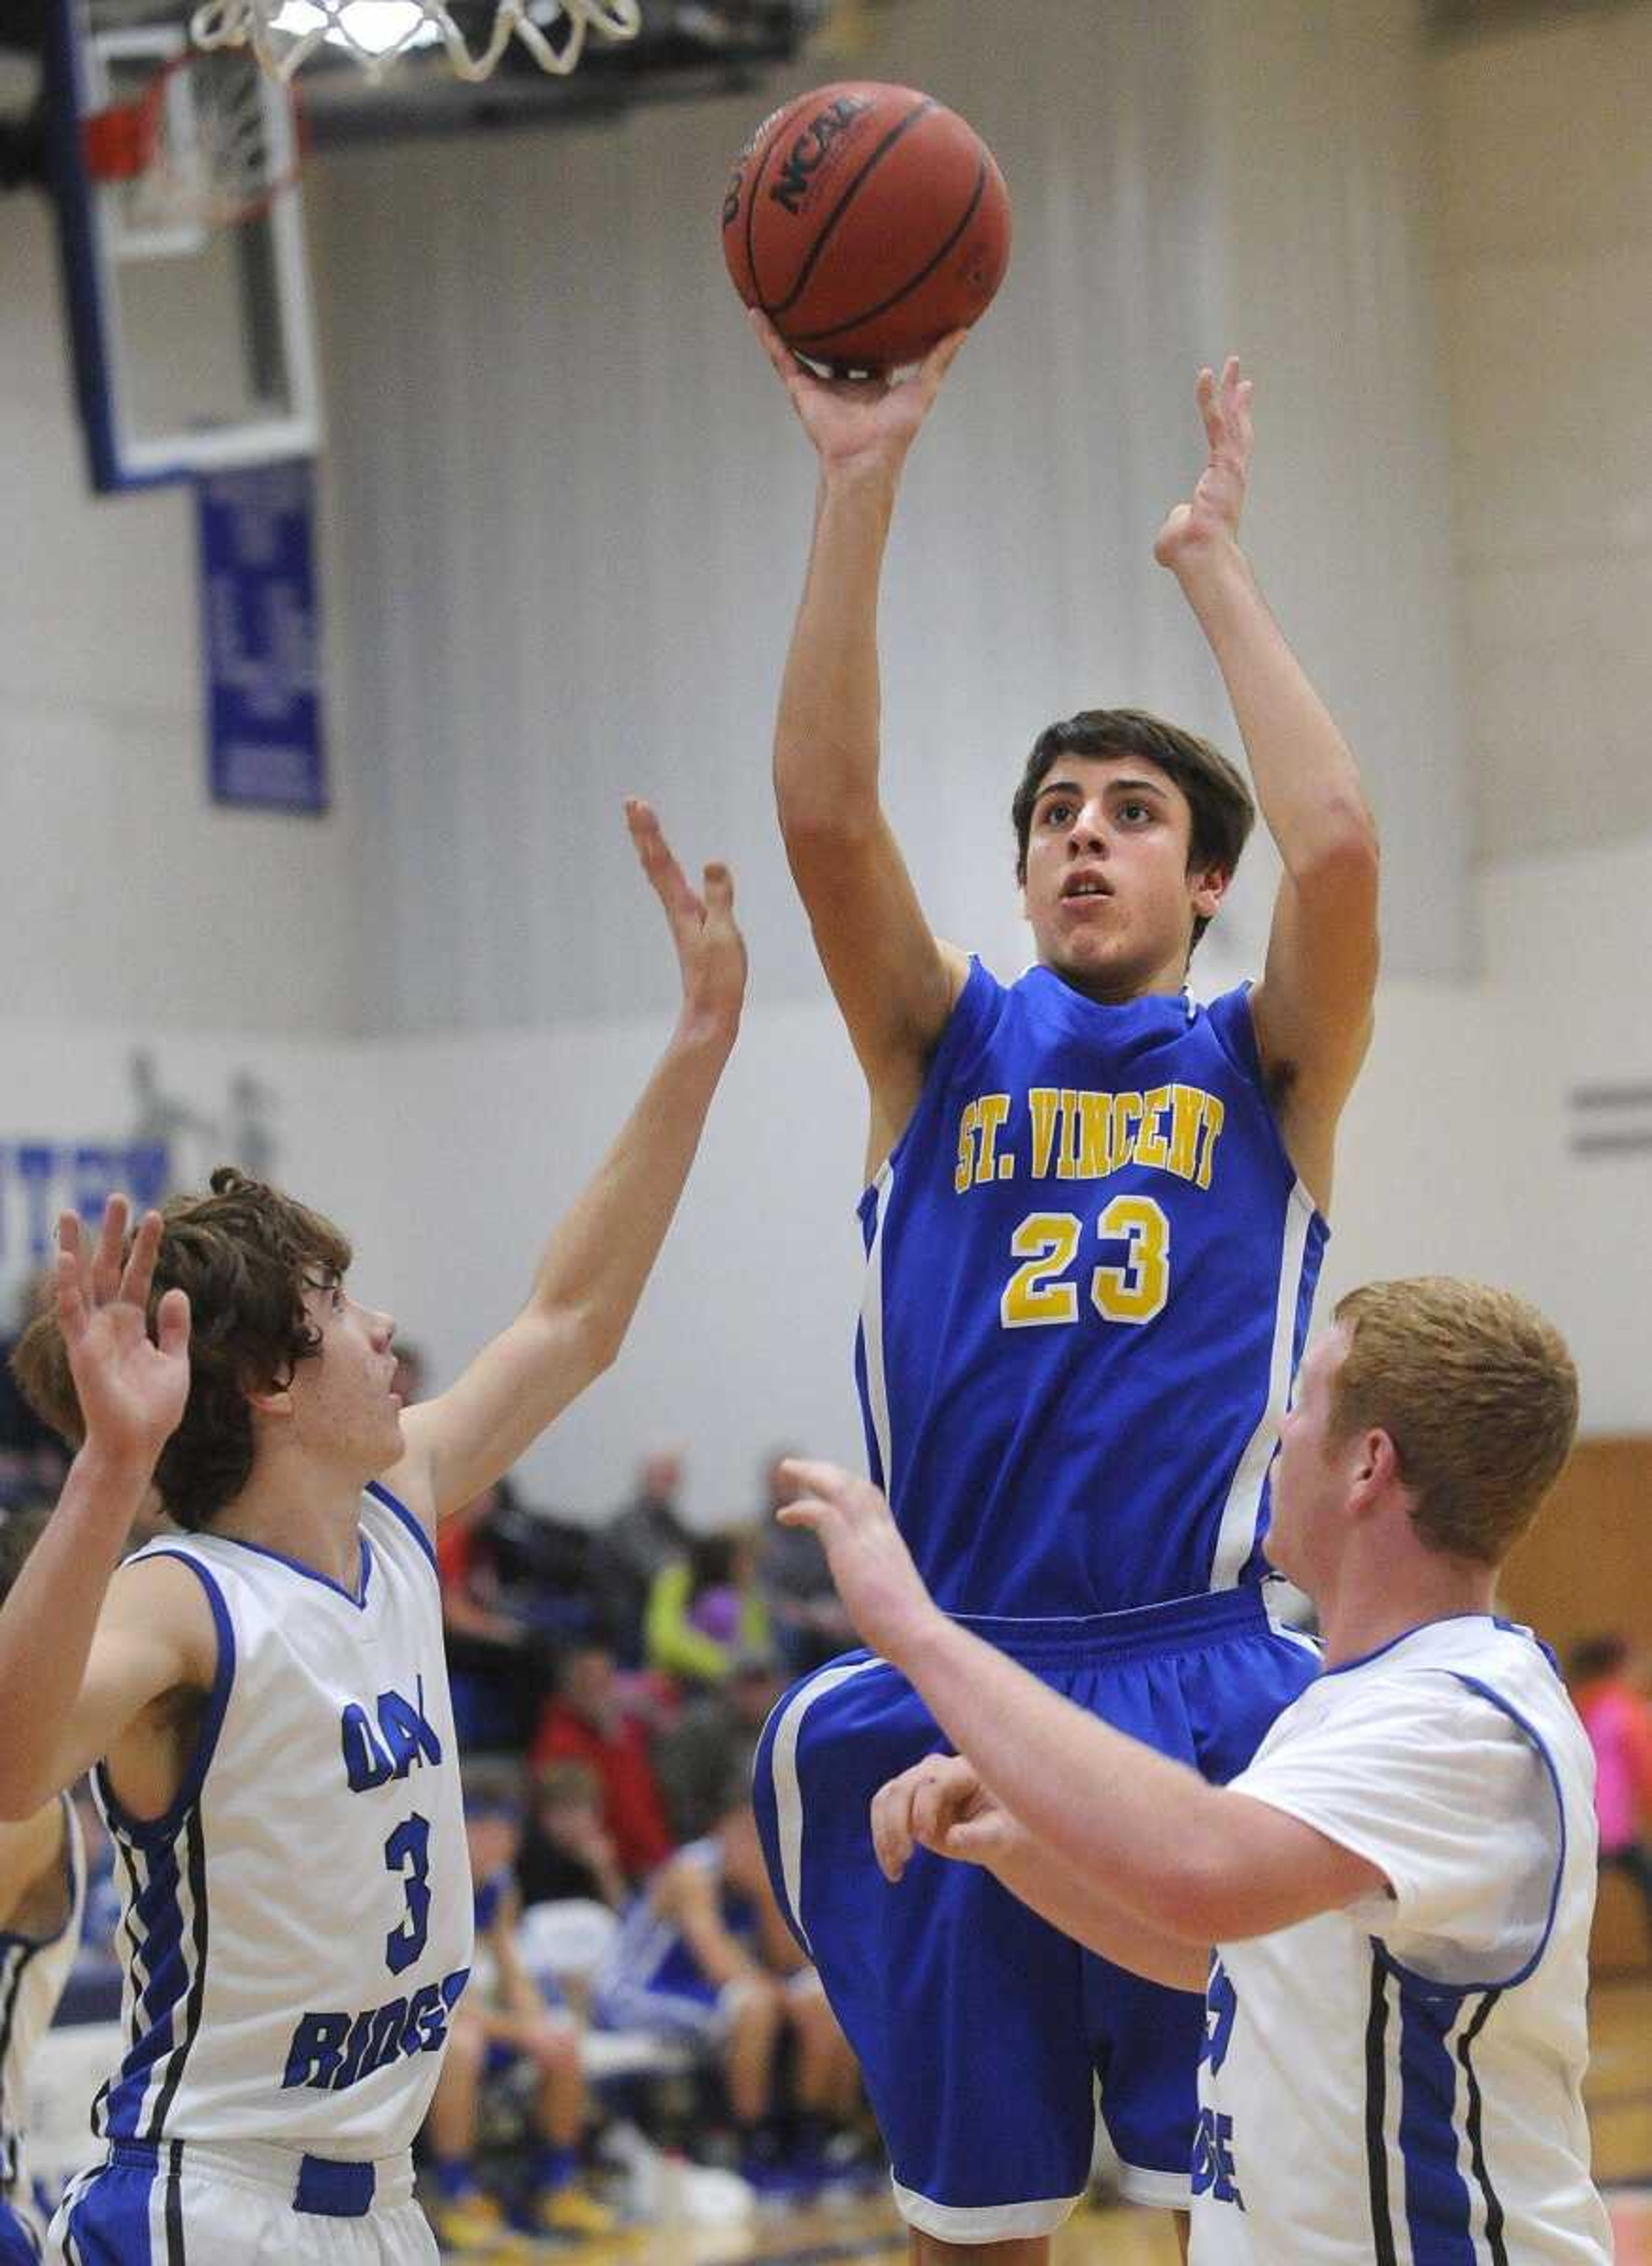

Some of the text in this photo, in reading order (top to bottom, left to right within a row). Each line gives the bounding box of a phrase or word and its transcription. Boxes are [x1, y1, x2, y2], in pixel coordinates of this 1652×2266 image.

[955, 1083, 1224, 1194] ST. VINCENT
[1000, 1194, 1170, 1329] 23
[385, 1812, 431, 1976] 3
